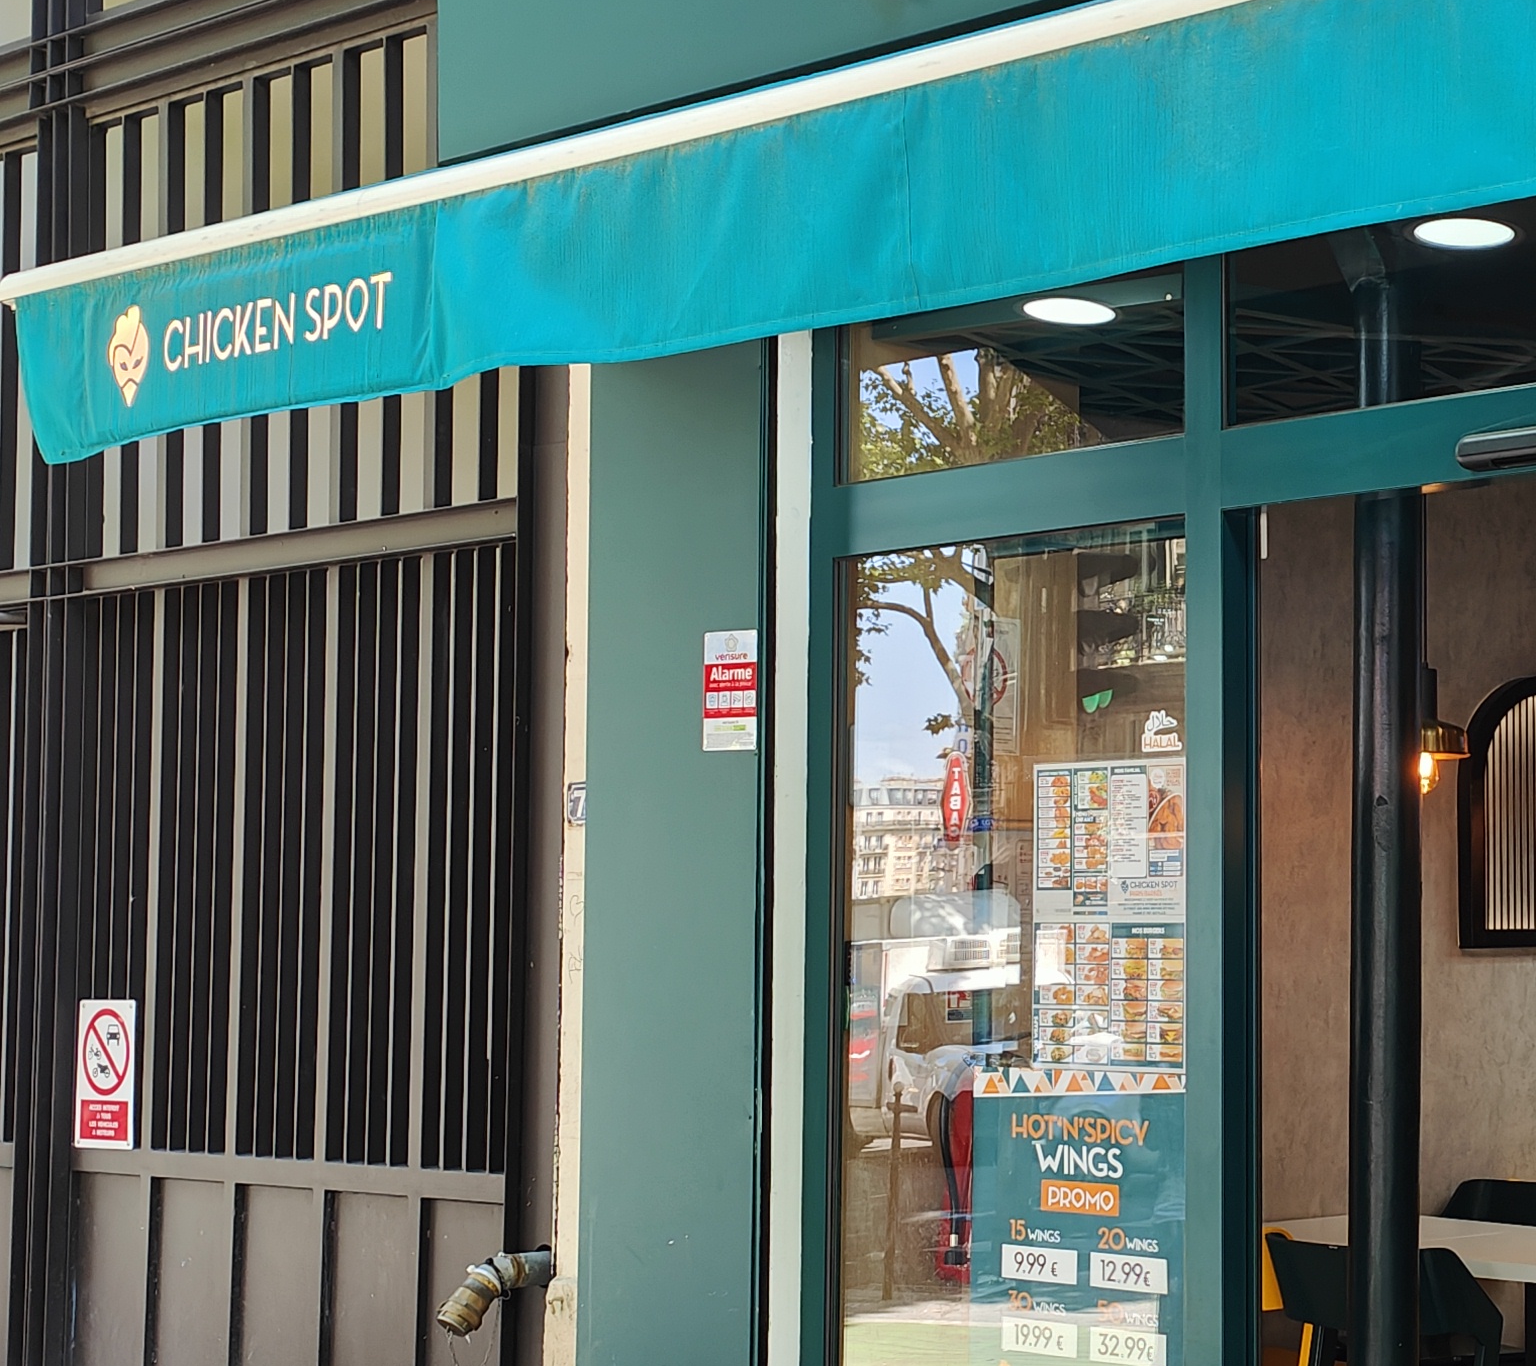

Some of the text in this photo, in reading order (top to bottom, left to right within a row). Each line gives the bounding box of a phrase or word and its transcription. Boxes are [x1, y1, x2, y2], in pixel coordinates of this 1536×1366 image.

[164, 271, 393, 372] CHICKEN SPOT
[715, 653, 749, 661] verisure
[710, 665, 753, 682] Alarme
[1143, 734, 1180, 749] HALAL
[1130, 880, 1178, 889] CHICKEN SPOT
[1011, 1113, 1149, 1146] HOT'N'SPICY
[1035, 1143, 1124, 1179] WINGS
[1048, 1186, 1114, 1212] PROMO
[1009, 1219, 1061, 1243] 15 WINGS
[1097, 1227, 1159, 1253] 20 WINGS
[1008, 1290, 1066, 1316] 30 WINGS
[1097, 1300, 1160, 1327] 50 WINGS
